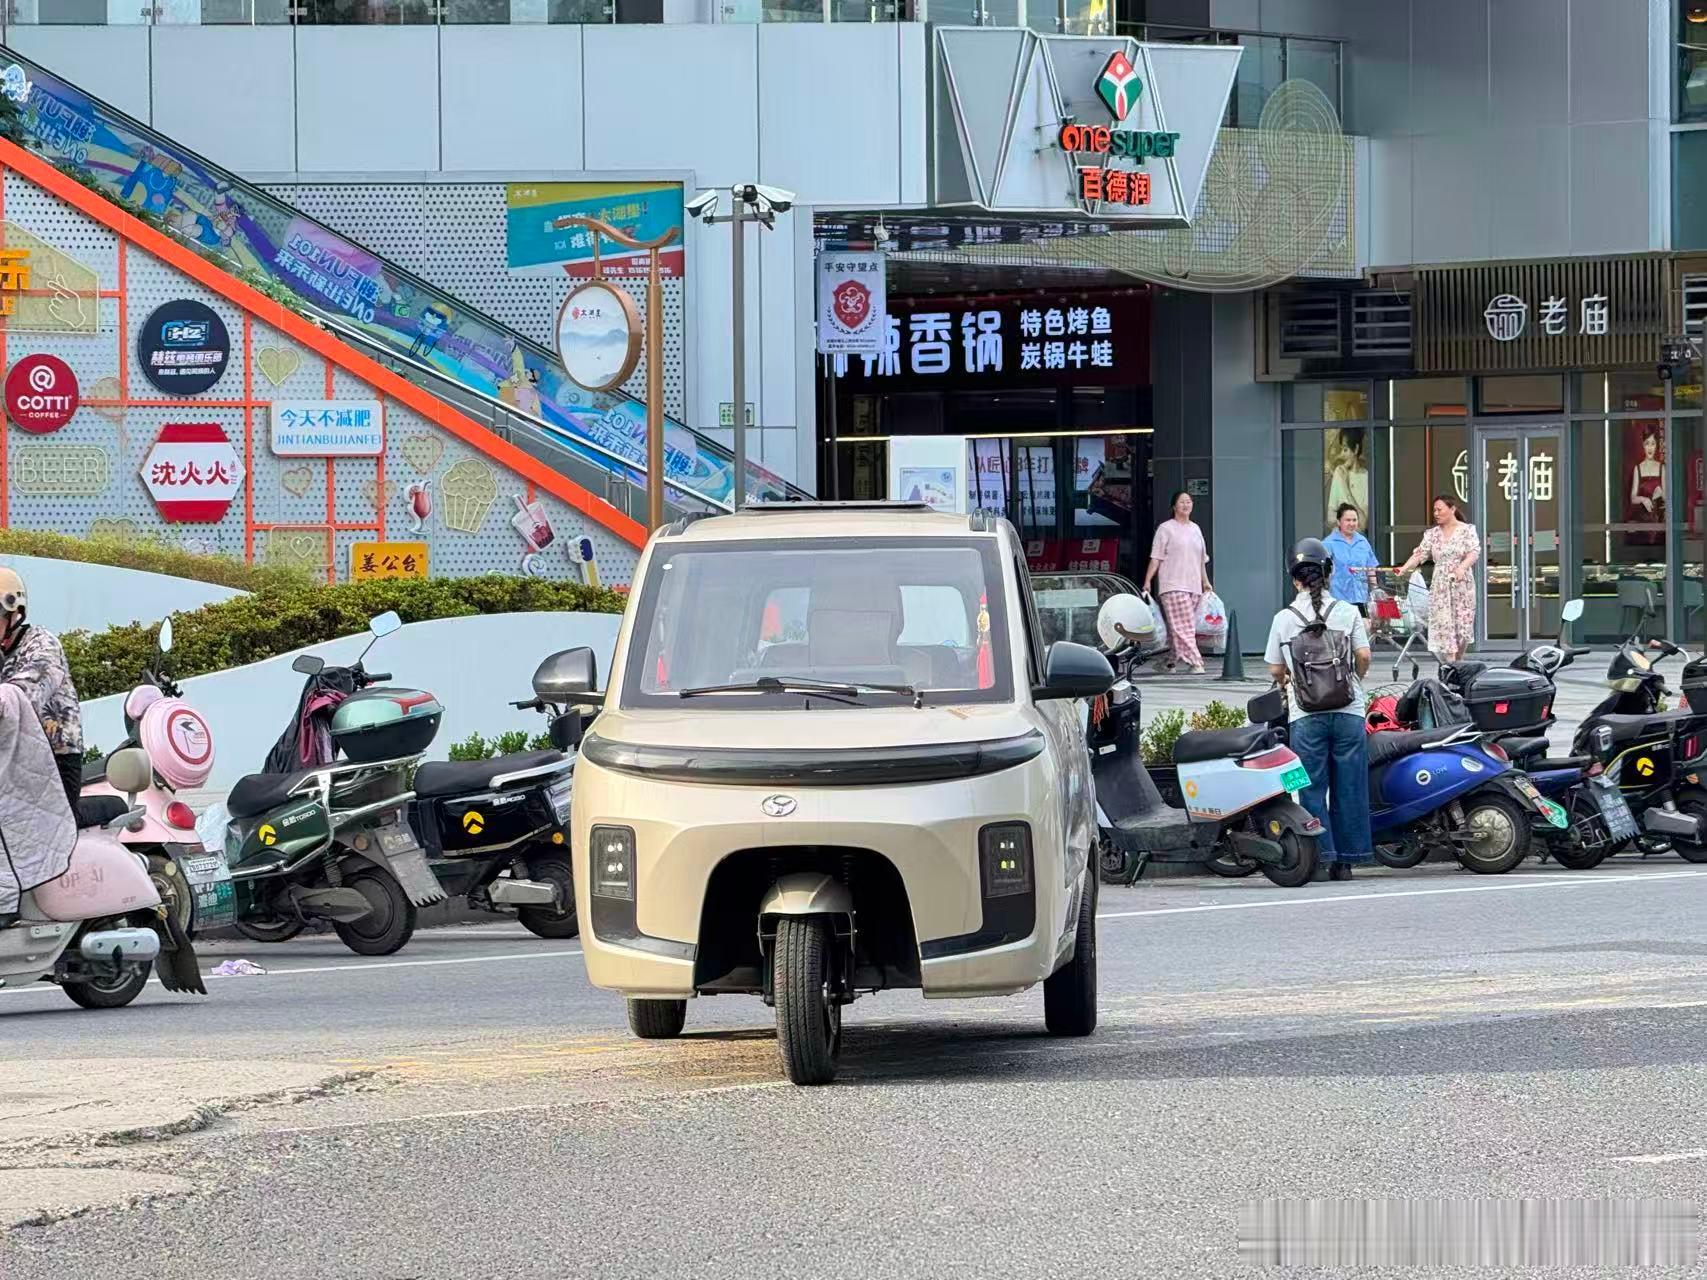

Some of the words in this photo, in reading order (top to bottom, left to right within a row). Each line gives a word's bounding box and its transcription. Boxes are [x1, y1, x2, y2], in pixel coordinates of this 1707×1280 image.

[1080, 167, 1151, 205] 百德润
[824, 262, 879, 272] 平安守望点
[1020, 307, 1113, 338] 特色烤鱼
[1539, 294, 1608, 335] 老庙
[1020, 340, 1113, 370] 炭锅牛蛙
[18, 395, 69, 410] COTTI
[281, 409, 371, 427] 今天不减肥
[278, 434, 381, 444] JINTIANBUJIANFEI
[22, 457, 101, 483] BEER
[152, 461, 229, 486] 沈火火
[1498, 452, 1553, 500] 老庙
[360, 552, 417, 573] 姜公台
